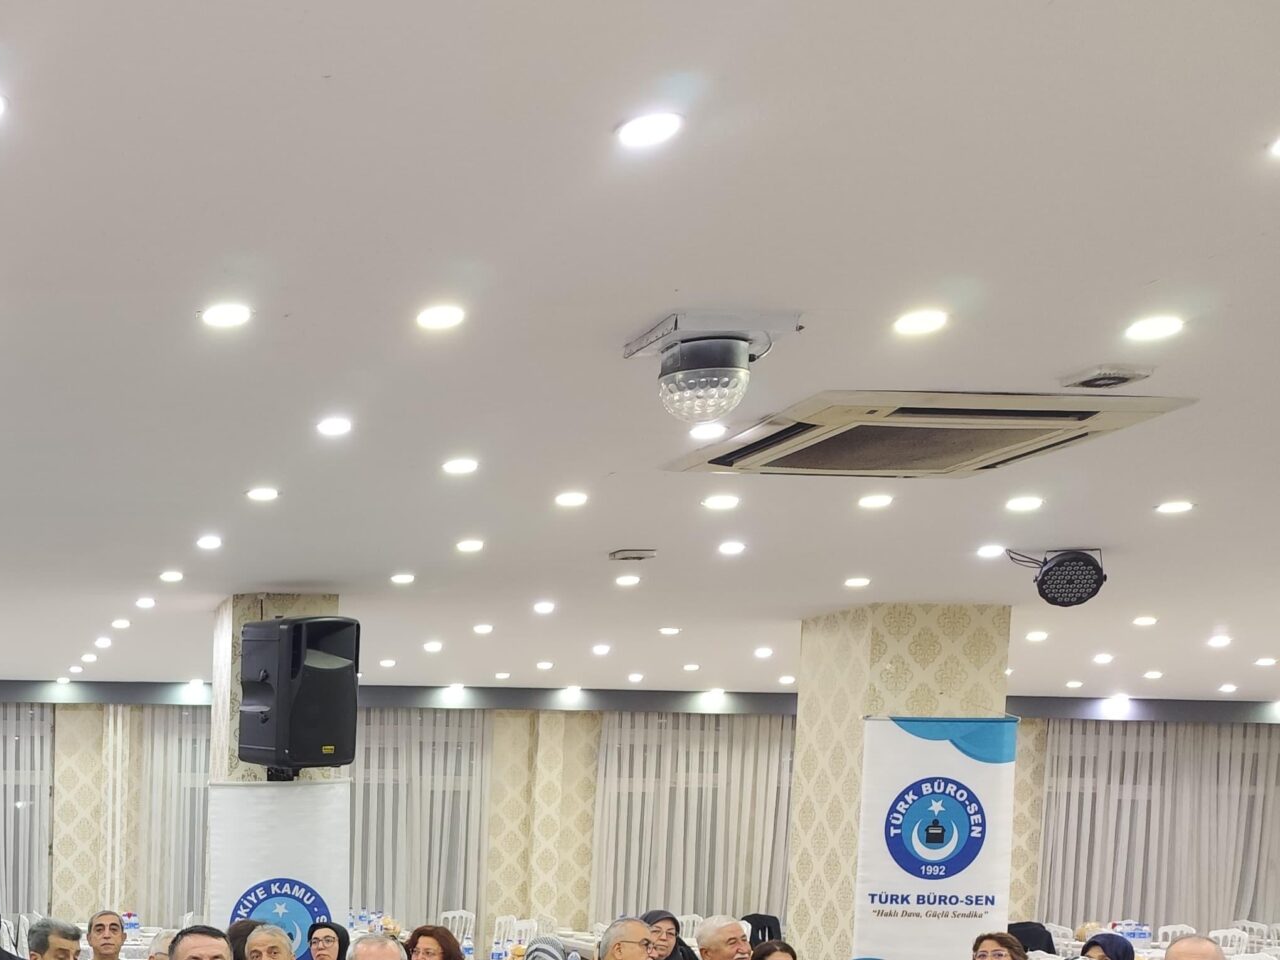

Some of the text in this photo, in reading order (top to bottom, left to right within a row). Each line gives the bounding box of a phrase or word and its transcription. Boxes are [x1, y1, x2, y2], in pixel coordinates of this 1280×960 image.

[890, 779, 983, 838] TÜRK BÜRO-SEN
[920, 864, 946, 876] 1992
[270, 882, 316, 905] KAMU
[868, 891, 995, 906] TÜRK BÜRO-SEN
[900, 909, 923, 919] Dava,
[925, 909, 949, 920] Güçlü
